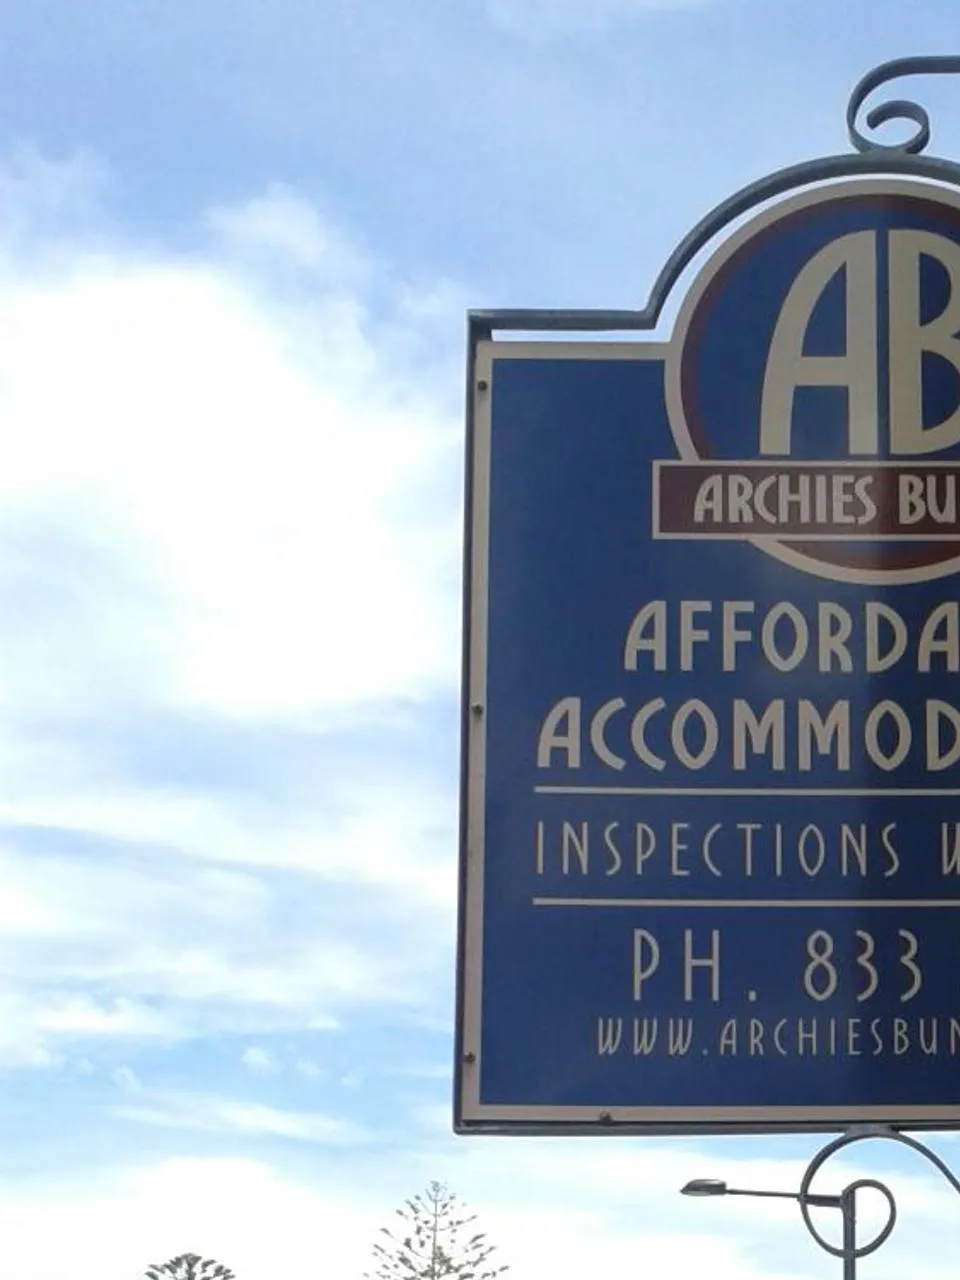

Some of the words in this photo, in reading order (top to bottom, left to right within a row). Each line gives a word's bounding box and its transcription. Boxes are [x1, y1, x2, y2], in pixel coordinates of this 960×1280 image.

[694, 475, 877, 526] ARCHIES
[535, 820, 899, 876] INSPECTIONS
[633, 928, 757, 1001] PH.
[804, 929, 921, 1002] 833
